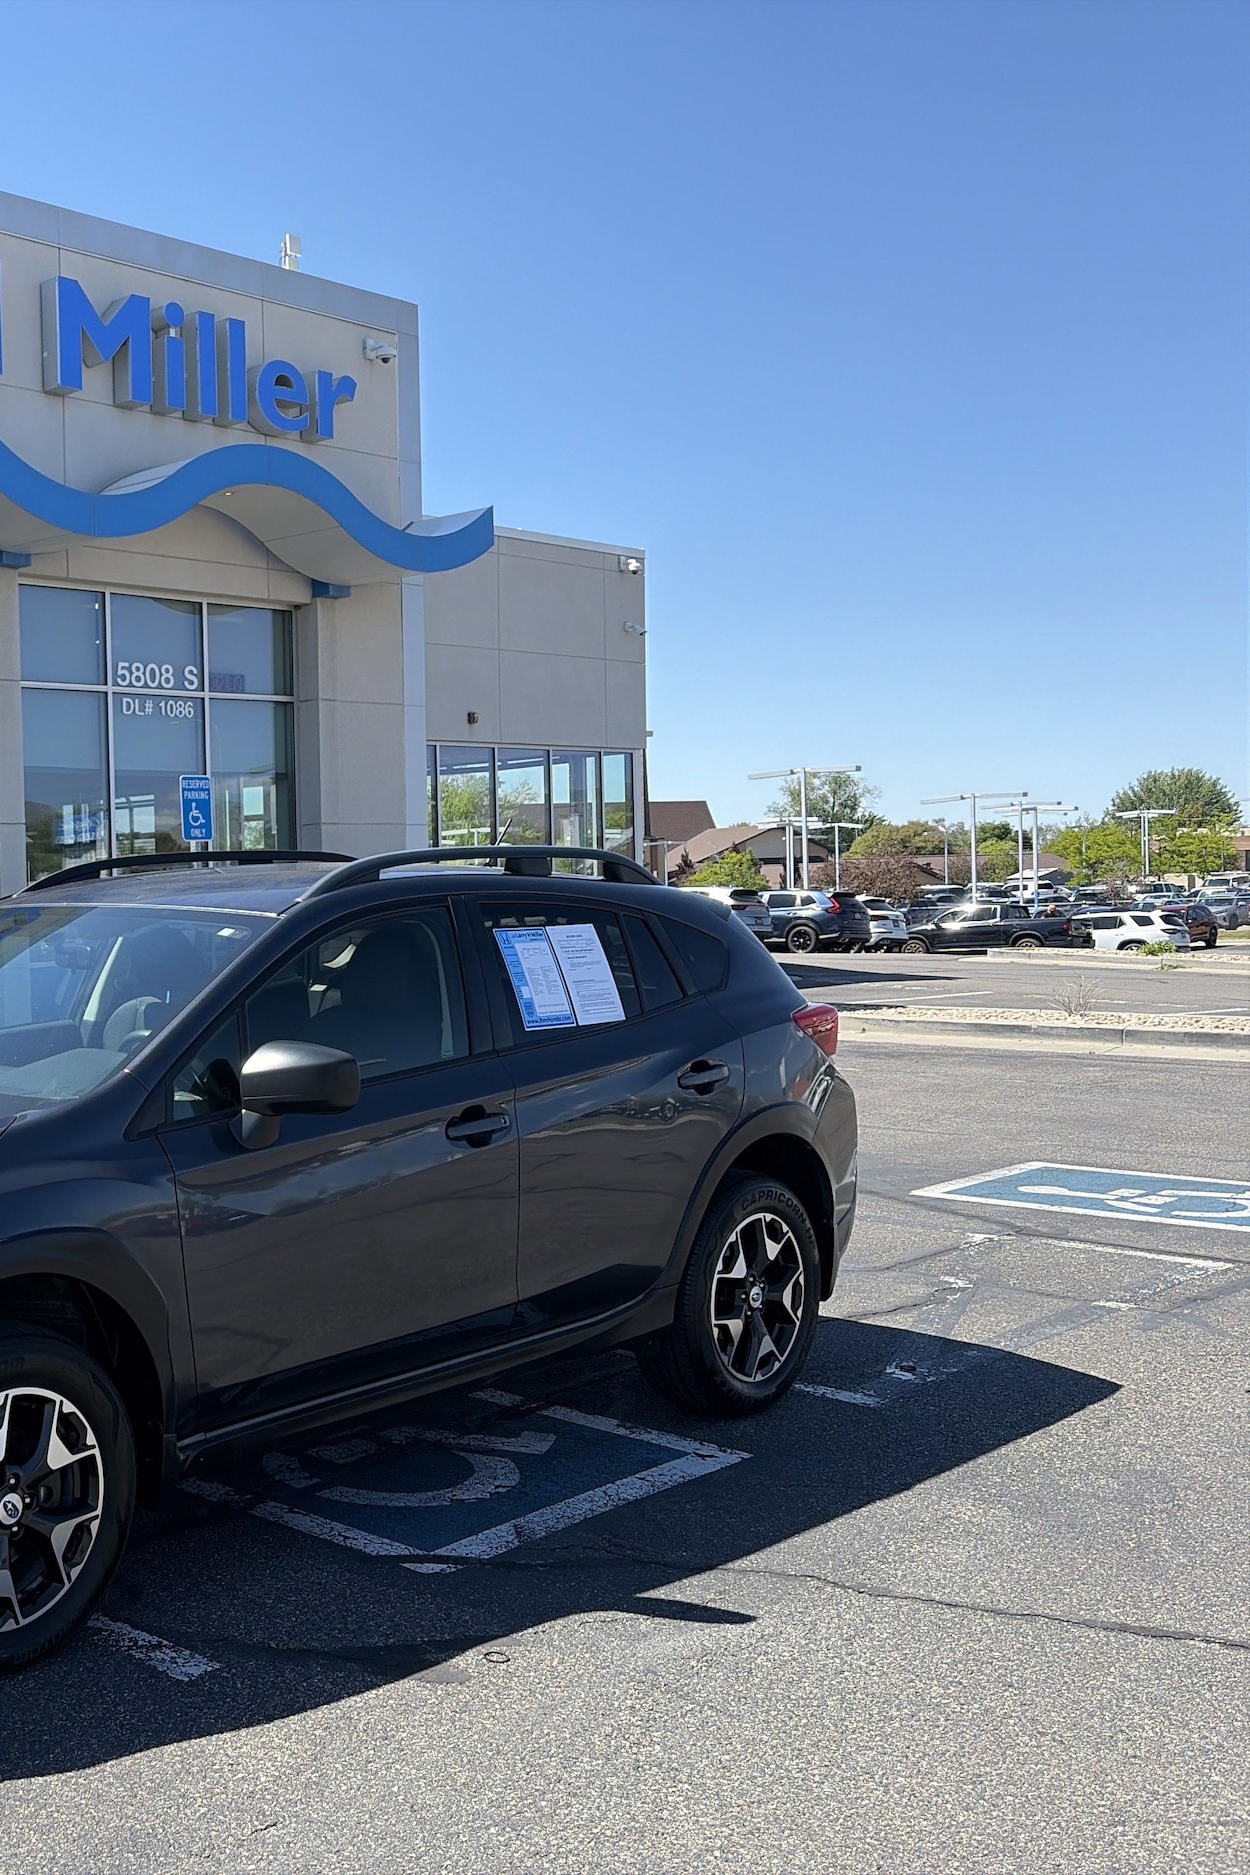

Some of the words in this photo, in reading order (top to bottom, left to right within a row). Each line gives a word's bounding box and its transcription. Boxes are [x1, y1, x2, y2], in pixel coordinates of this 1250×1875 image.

[42, 275, 356, 442] Miller
[116, 662, 174, 688] 5808
[184, 665, 198, 690] S
[122, 698, 153, 715] DL#
[159, 700, 194, 718] 1086
[182, 780, 209, 789] RESERVED
[183, 791, 209, 800] PARKING
[190, 828, 206, 837] ONLY
[742, 1190, 806, 1224] CAPRICORN
